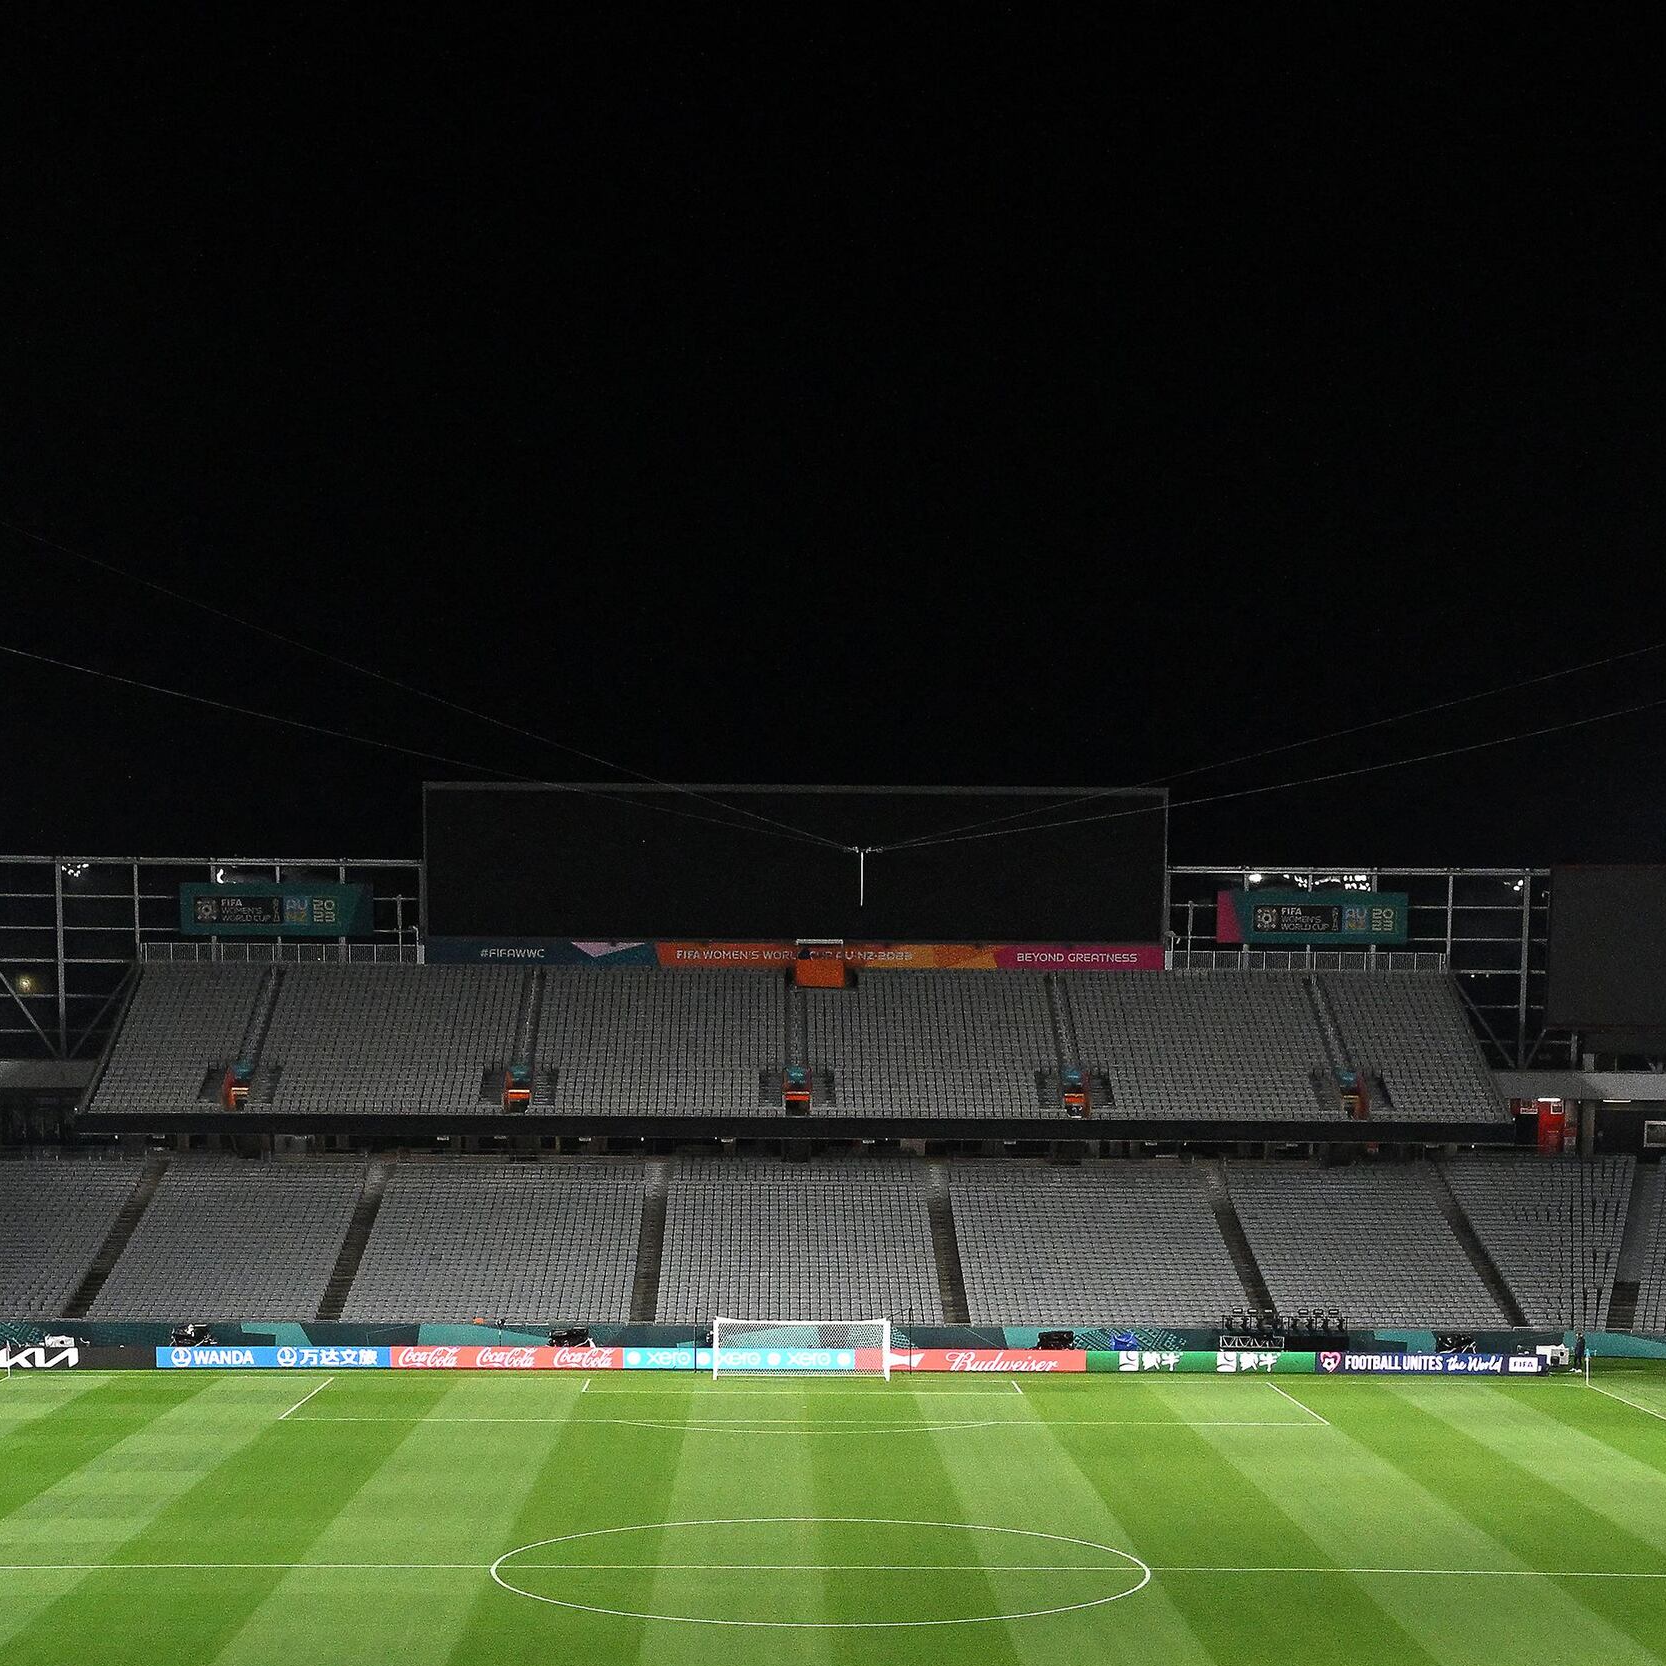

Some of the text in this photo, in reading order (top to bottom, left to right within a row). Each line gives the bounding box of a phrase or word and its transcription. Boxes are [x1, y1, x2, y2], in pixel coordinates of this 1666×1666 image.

[221, 899, 242, 907] FIFA
[1281, 923, 1330, 931] WORLD CUP
[480, 948, 545, 959] #FIFAWWC
[676, 950, 702, 961] FIFA
[703, 950, 760, 961] WOMEN'S
[762, 951, 799, 962] WORL
[1017, 952, 1137, 962] BEYOND GREATNESS
[193, 1349, 254, 1366] WANDA
[647, 1350, 691, 1366] xero
[946, 1350, 1059, 1372] Budweiser
[1344, 1355, 1504, 1373] FOOTBALL UNITES the World
